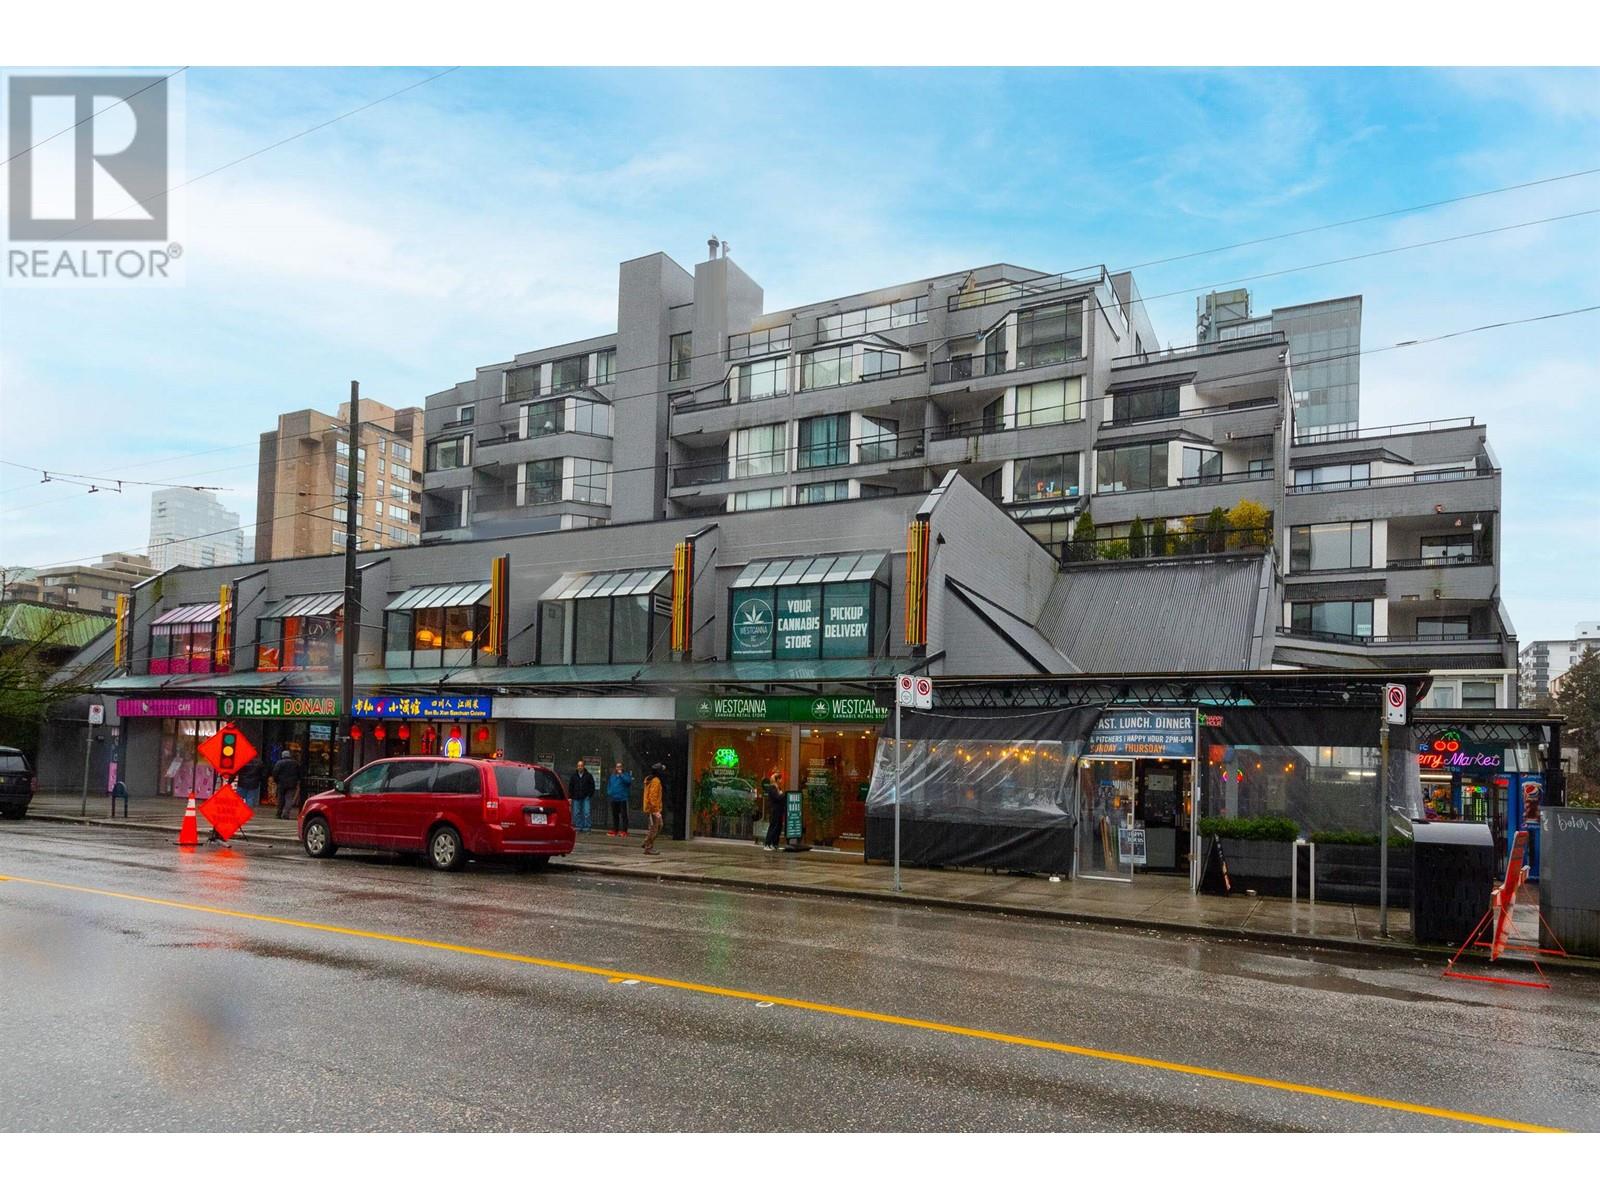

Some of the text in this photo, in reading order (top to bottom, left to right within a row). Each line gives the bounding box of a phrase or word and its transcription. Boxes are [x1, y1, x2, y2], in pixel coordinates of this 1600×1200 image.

[787, 599, 811, 613] YOUR
[830, 606, 863, 621] PICKUP
[777, 616, 820, 631] CANNABIS
[824, 622, 867, 638] DELIVERY
[785, 635, 812, 649] STORE
[237, 698, 335, 714] FRESH DONAIR
[714, 699, 767, 713] WESTCANNA
[1119, 717, 1153, 729] LUNCH.
[1156, 717, 1191, 729] DINNER
[1096, 735, 1122, 743] PITCHERS
[1127, 735, 1146, 743] HAPPY
[1147, 735, 1163, 743] HOUR
[1090, 744, 1116, 753] SUNDAY
[1417, 753, 1443, 768] erry
[1443, 752, 1500, 767] Market
